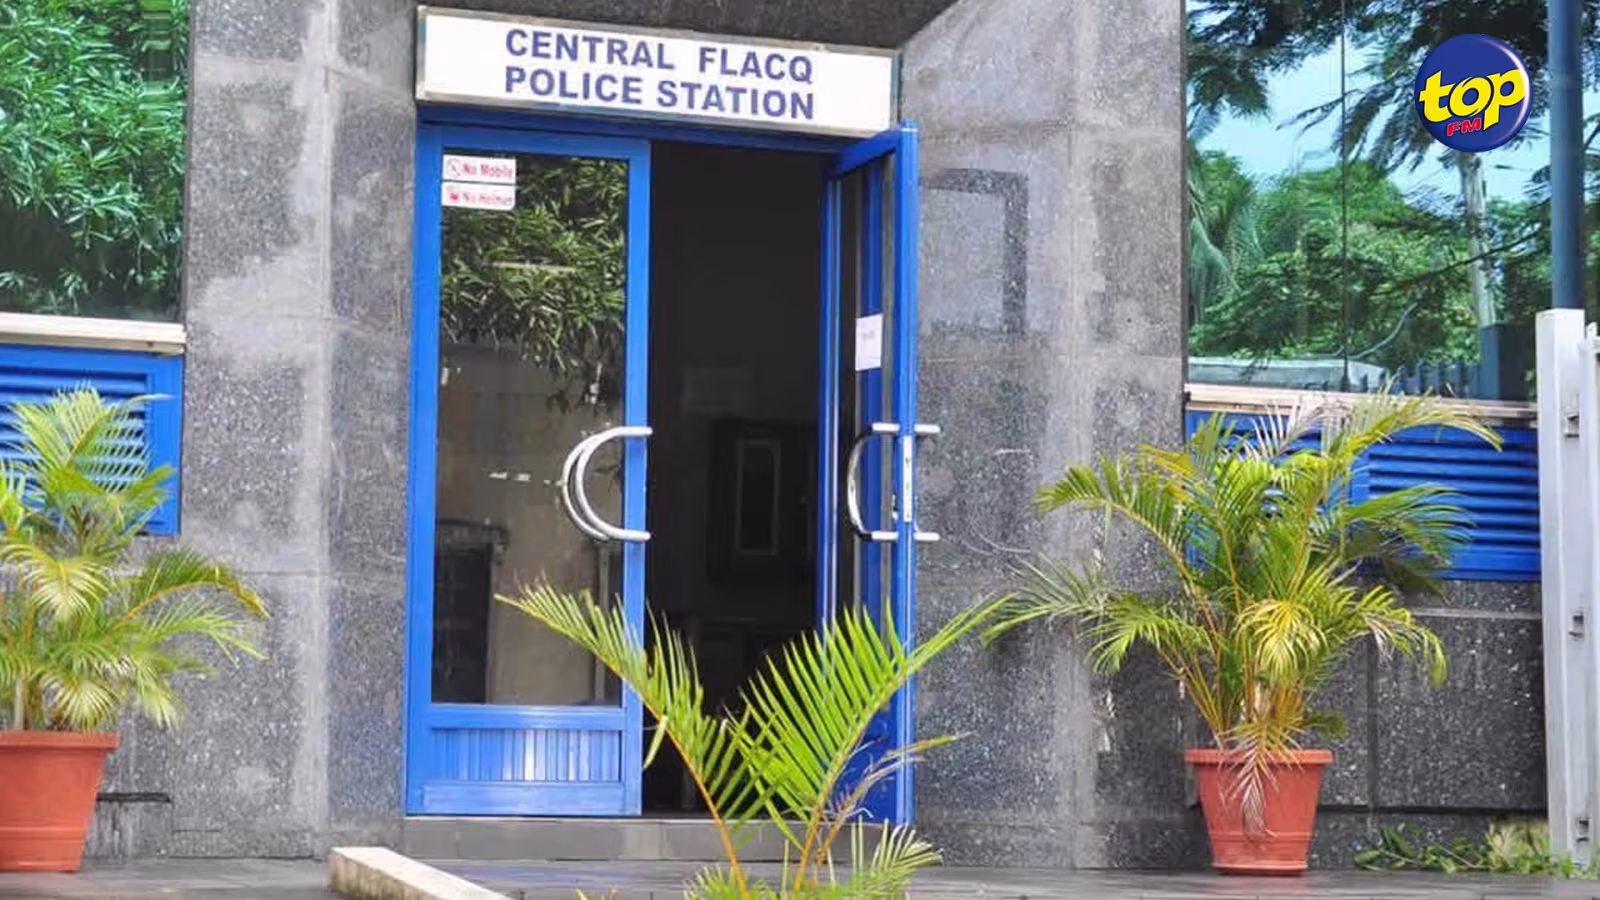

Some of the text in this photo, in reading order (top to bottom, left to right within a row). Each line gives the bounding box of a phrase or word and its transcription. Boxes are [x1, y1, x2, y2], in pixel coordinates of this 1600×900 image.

[505, 29, 813, 84] CENTRAL FLACQ
[505, 66, 814, 120] POLICE STATION
[463, 163, 514, 179] No Mobile
